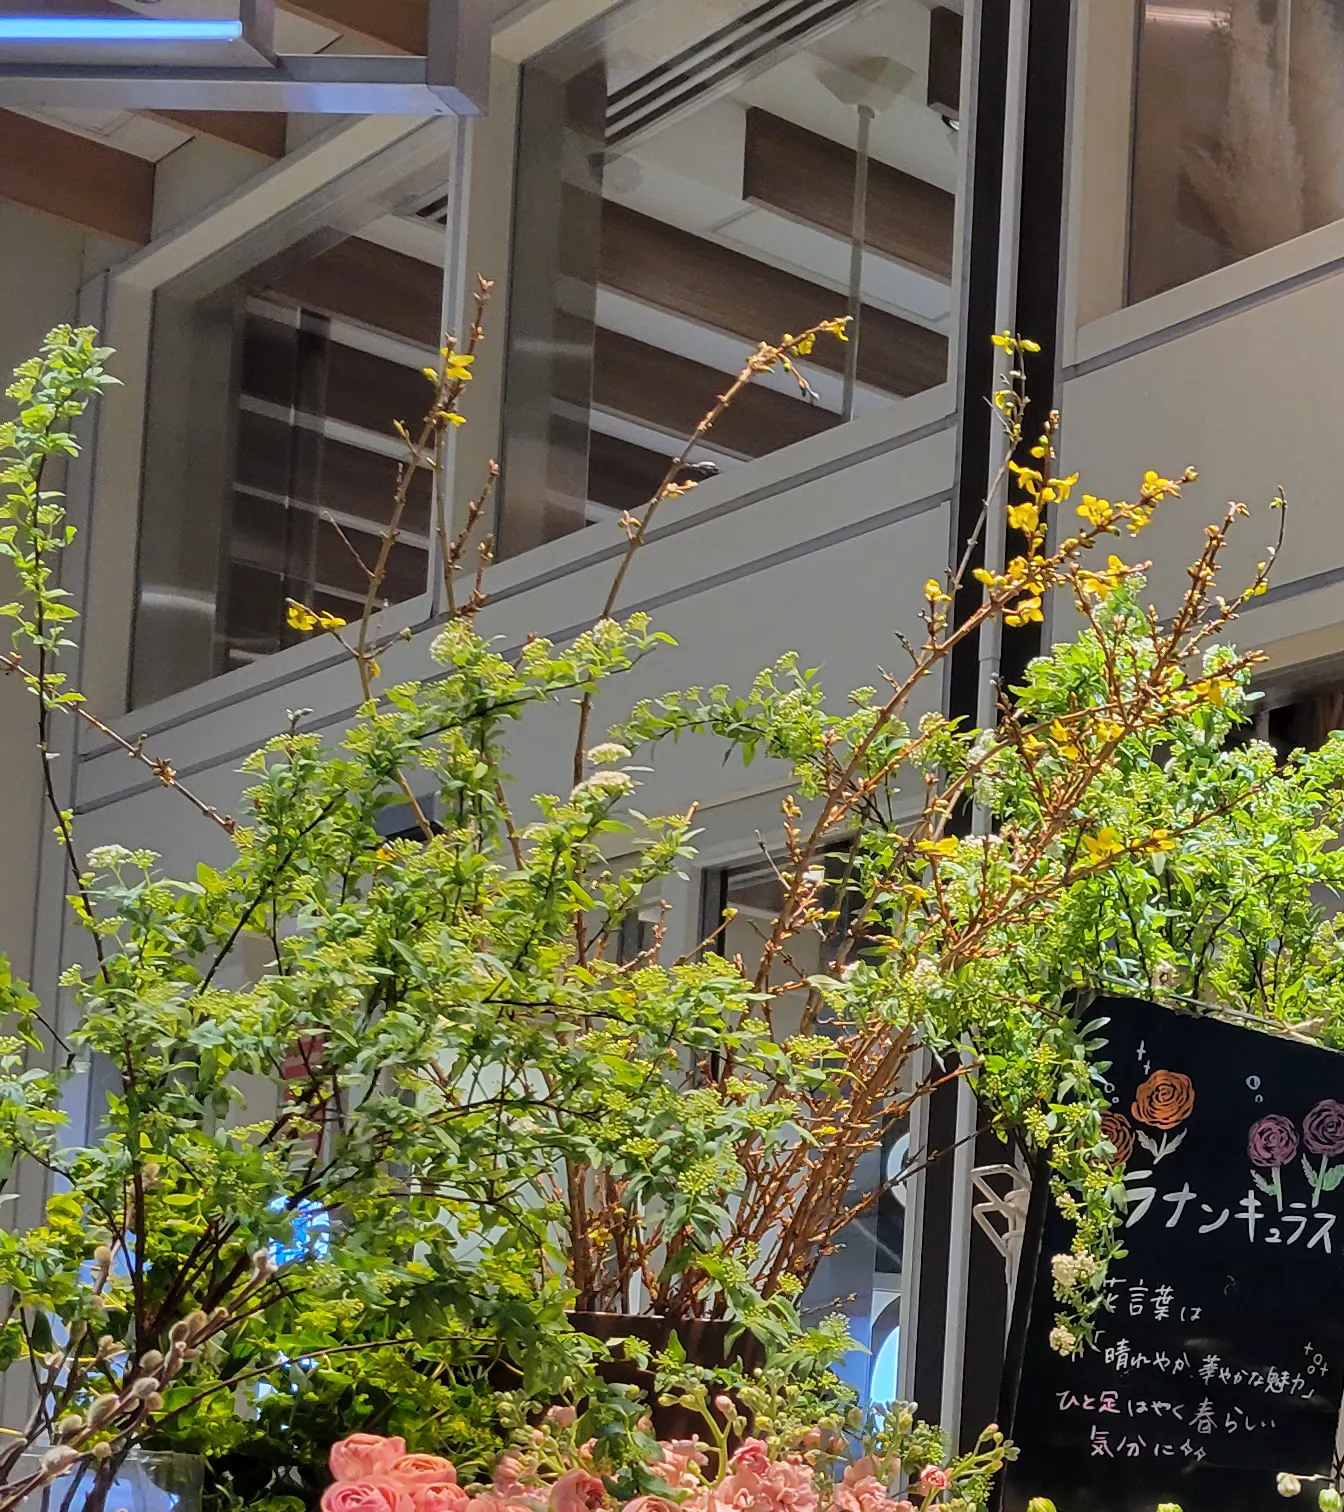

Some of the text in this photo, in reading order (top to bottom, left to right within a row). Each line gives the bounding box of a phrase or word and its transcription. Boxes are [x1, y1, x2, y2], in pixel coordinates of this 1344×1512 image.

[1124, 1169, 1337, 1254] ラナンキュラス
[1102, 1278, 1202, 1321] 花言葉は
